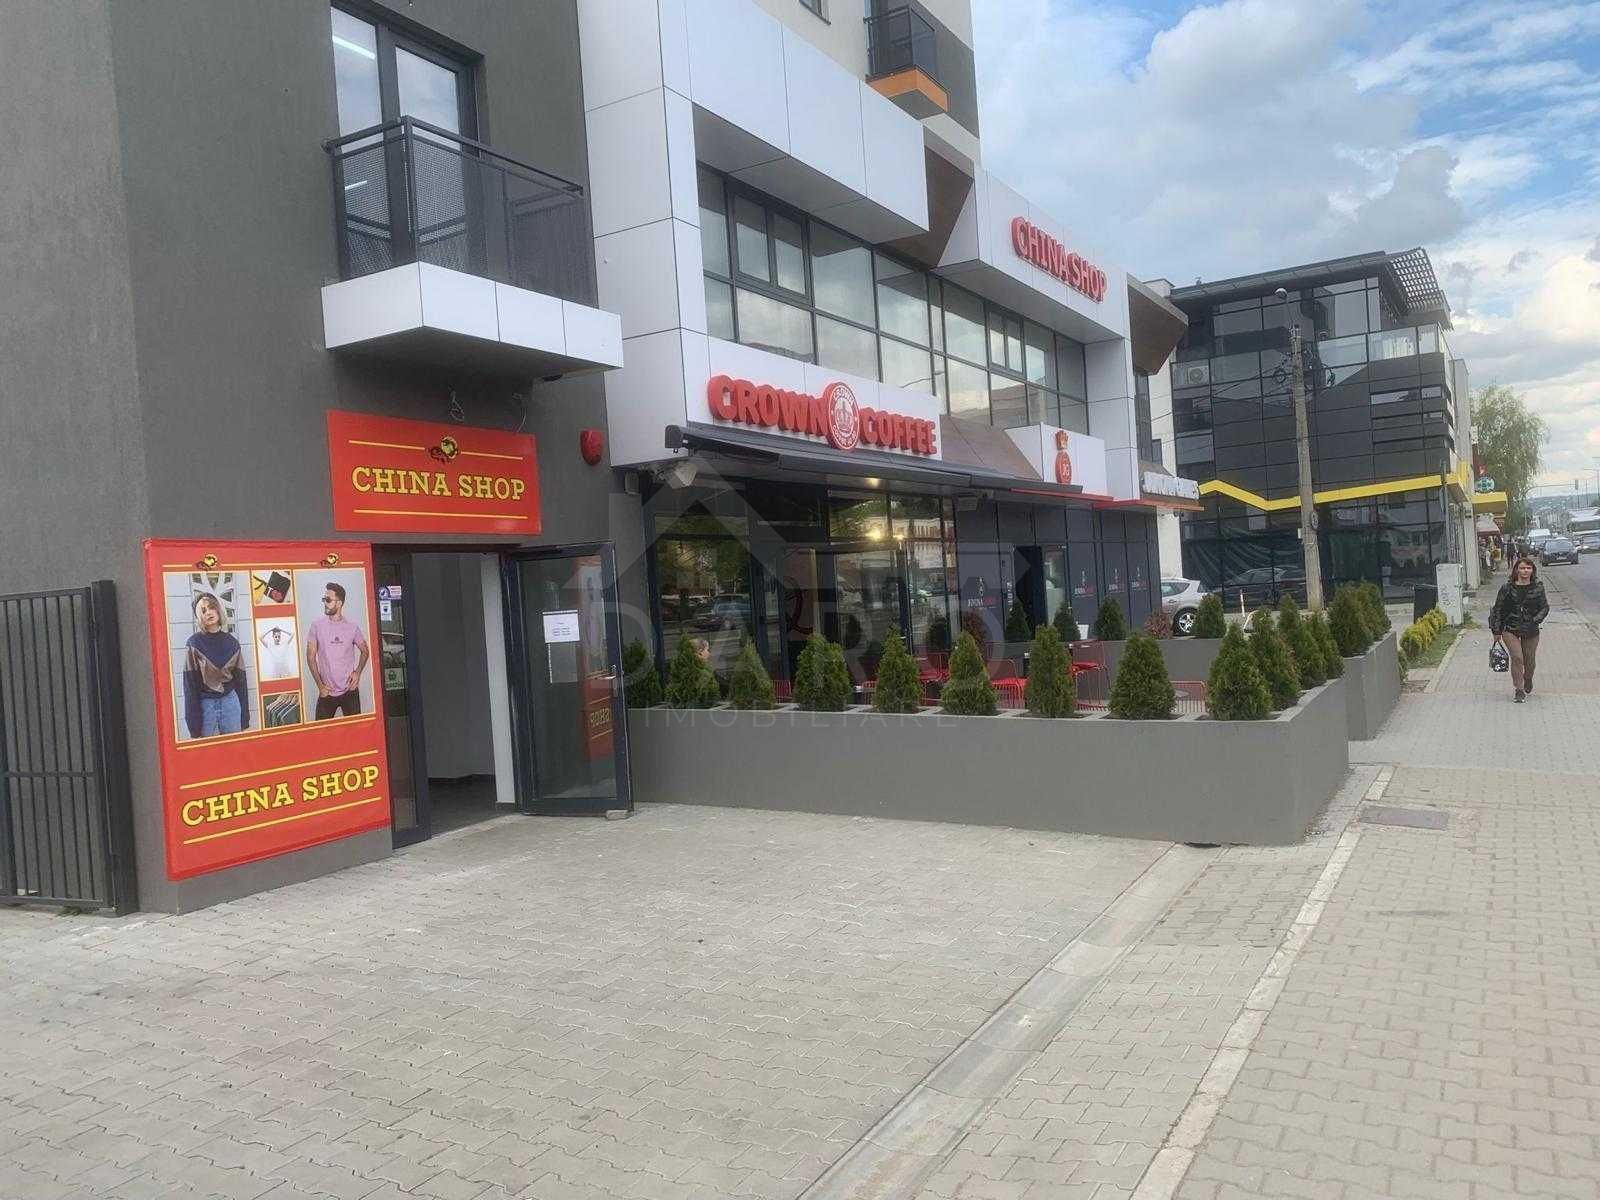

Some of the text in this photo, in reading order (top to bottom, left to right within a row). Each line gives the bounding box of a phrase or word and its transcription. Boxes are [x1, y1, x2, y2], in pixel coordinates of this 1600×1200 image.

[1011, 216, 1106, 303] CHINA SHOP
[708, 375, 829, 437] CROWN
[859, 407, 937, 454] COFFEE
[352, 466, 525, 500] CHINA SHOP
[181, 764, 380, 827] CHINA SHOP
